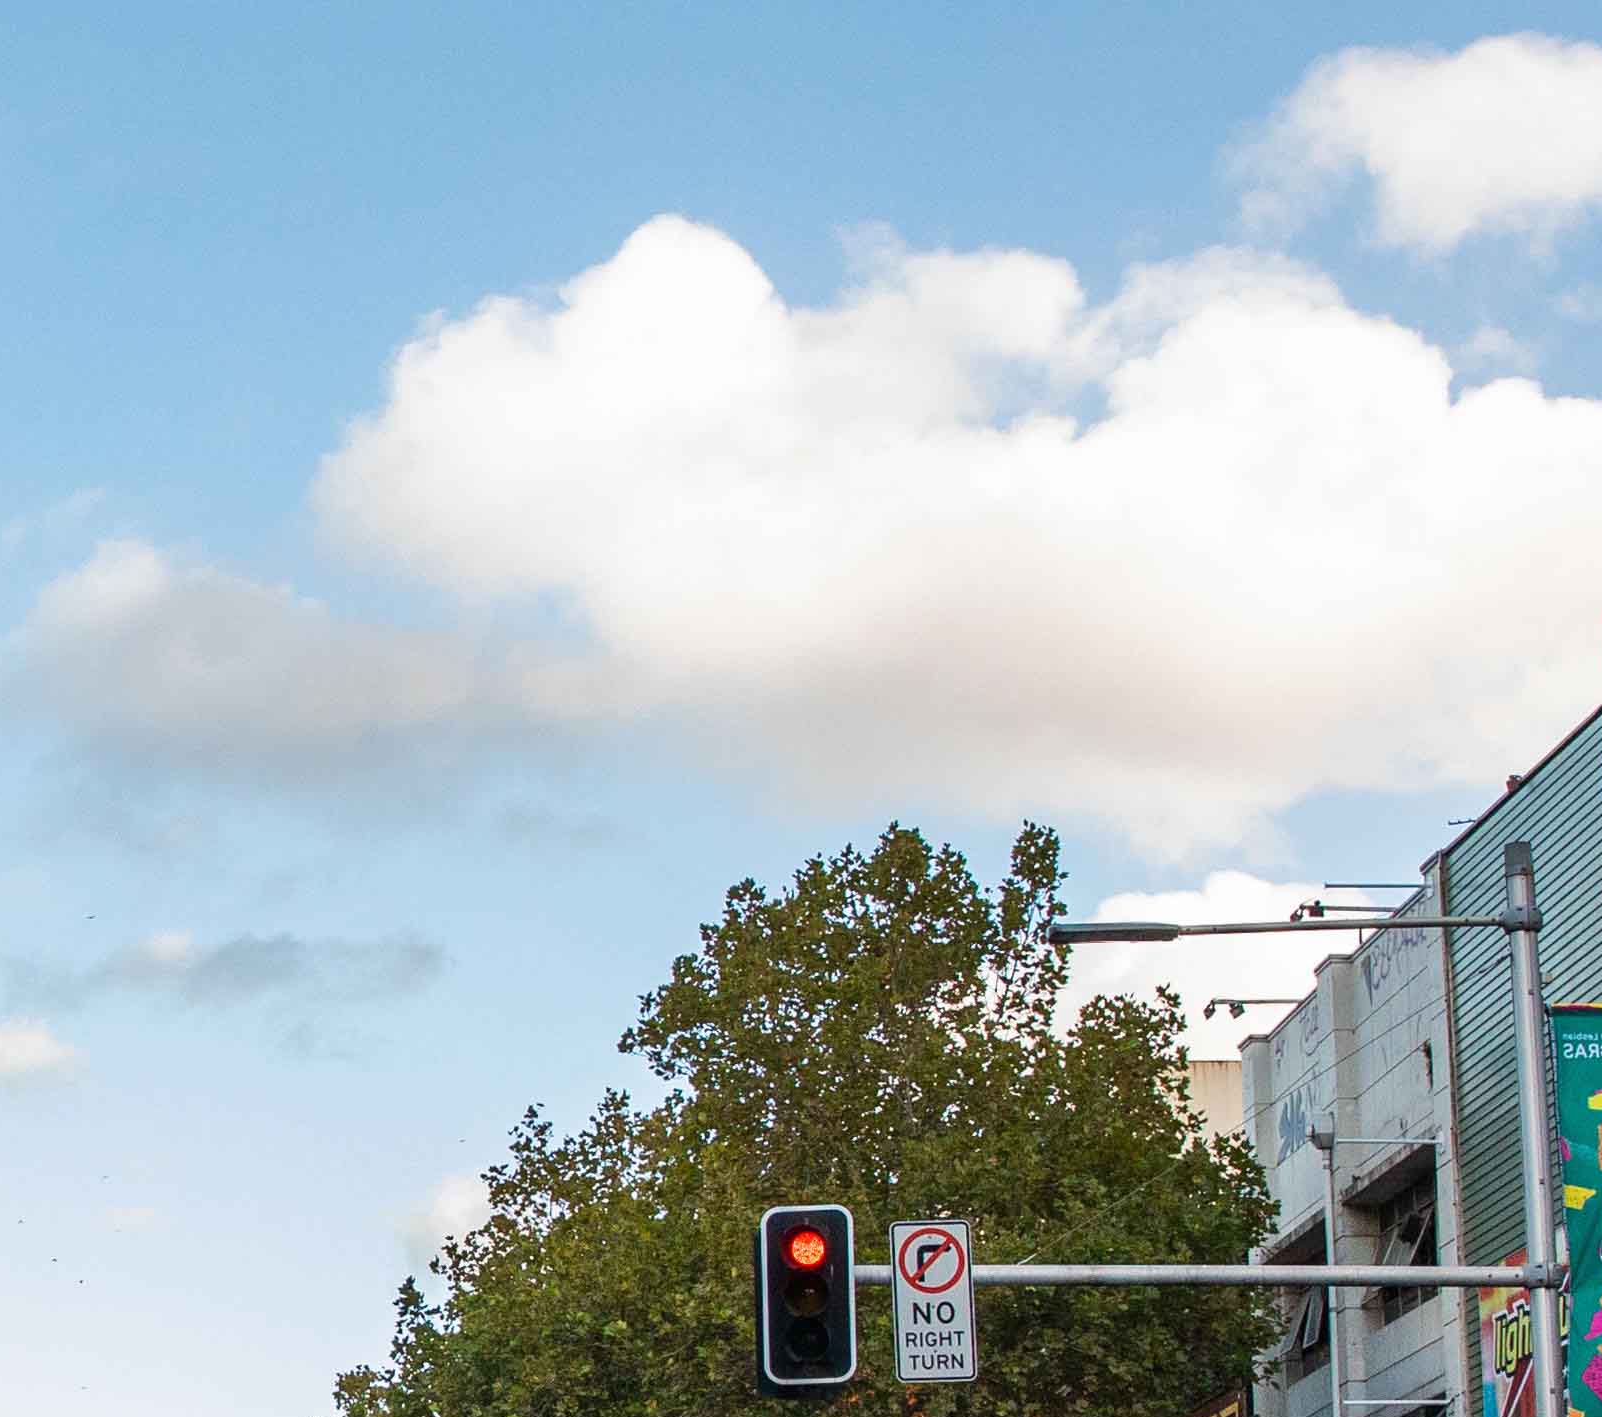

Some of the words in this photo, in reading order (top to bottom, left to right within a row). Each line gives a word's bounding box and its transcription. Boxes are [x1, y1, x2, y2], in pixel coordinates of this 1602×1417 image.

[912, 1301, 955, 1325] NO
[905, 1330, 965, 1348] RIGHT
[908, 1353, 964, 1371] TURN
